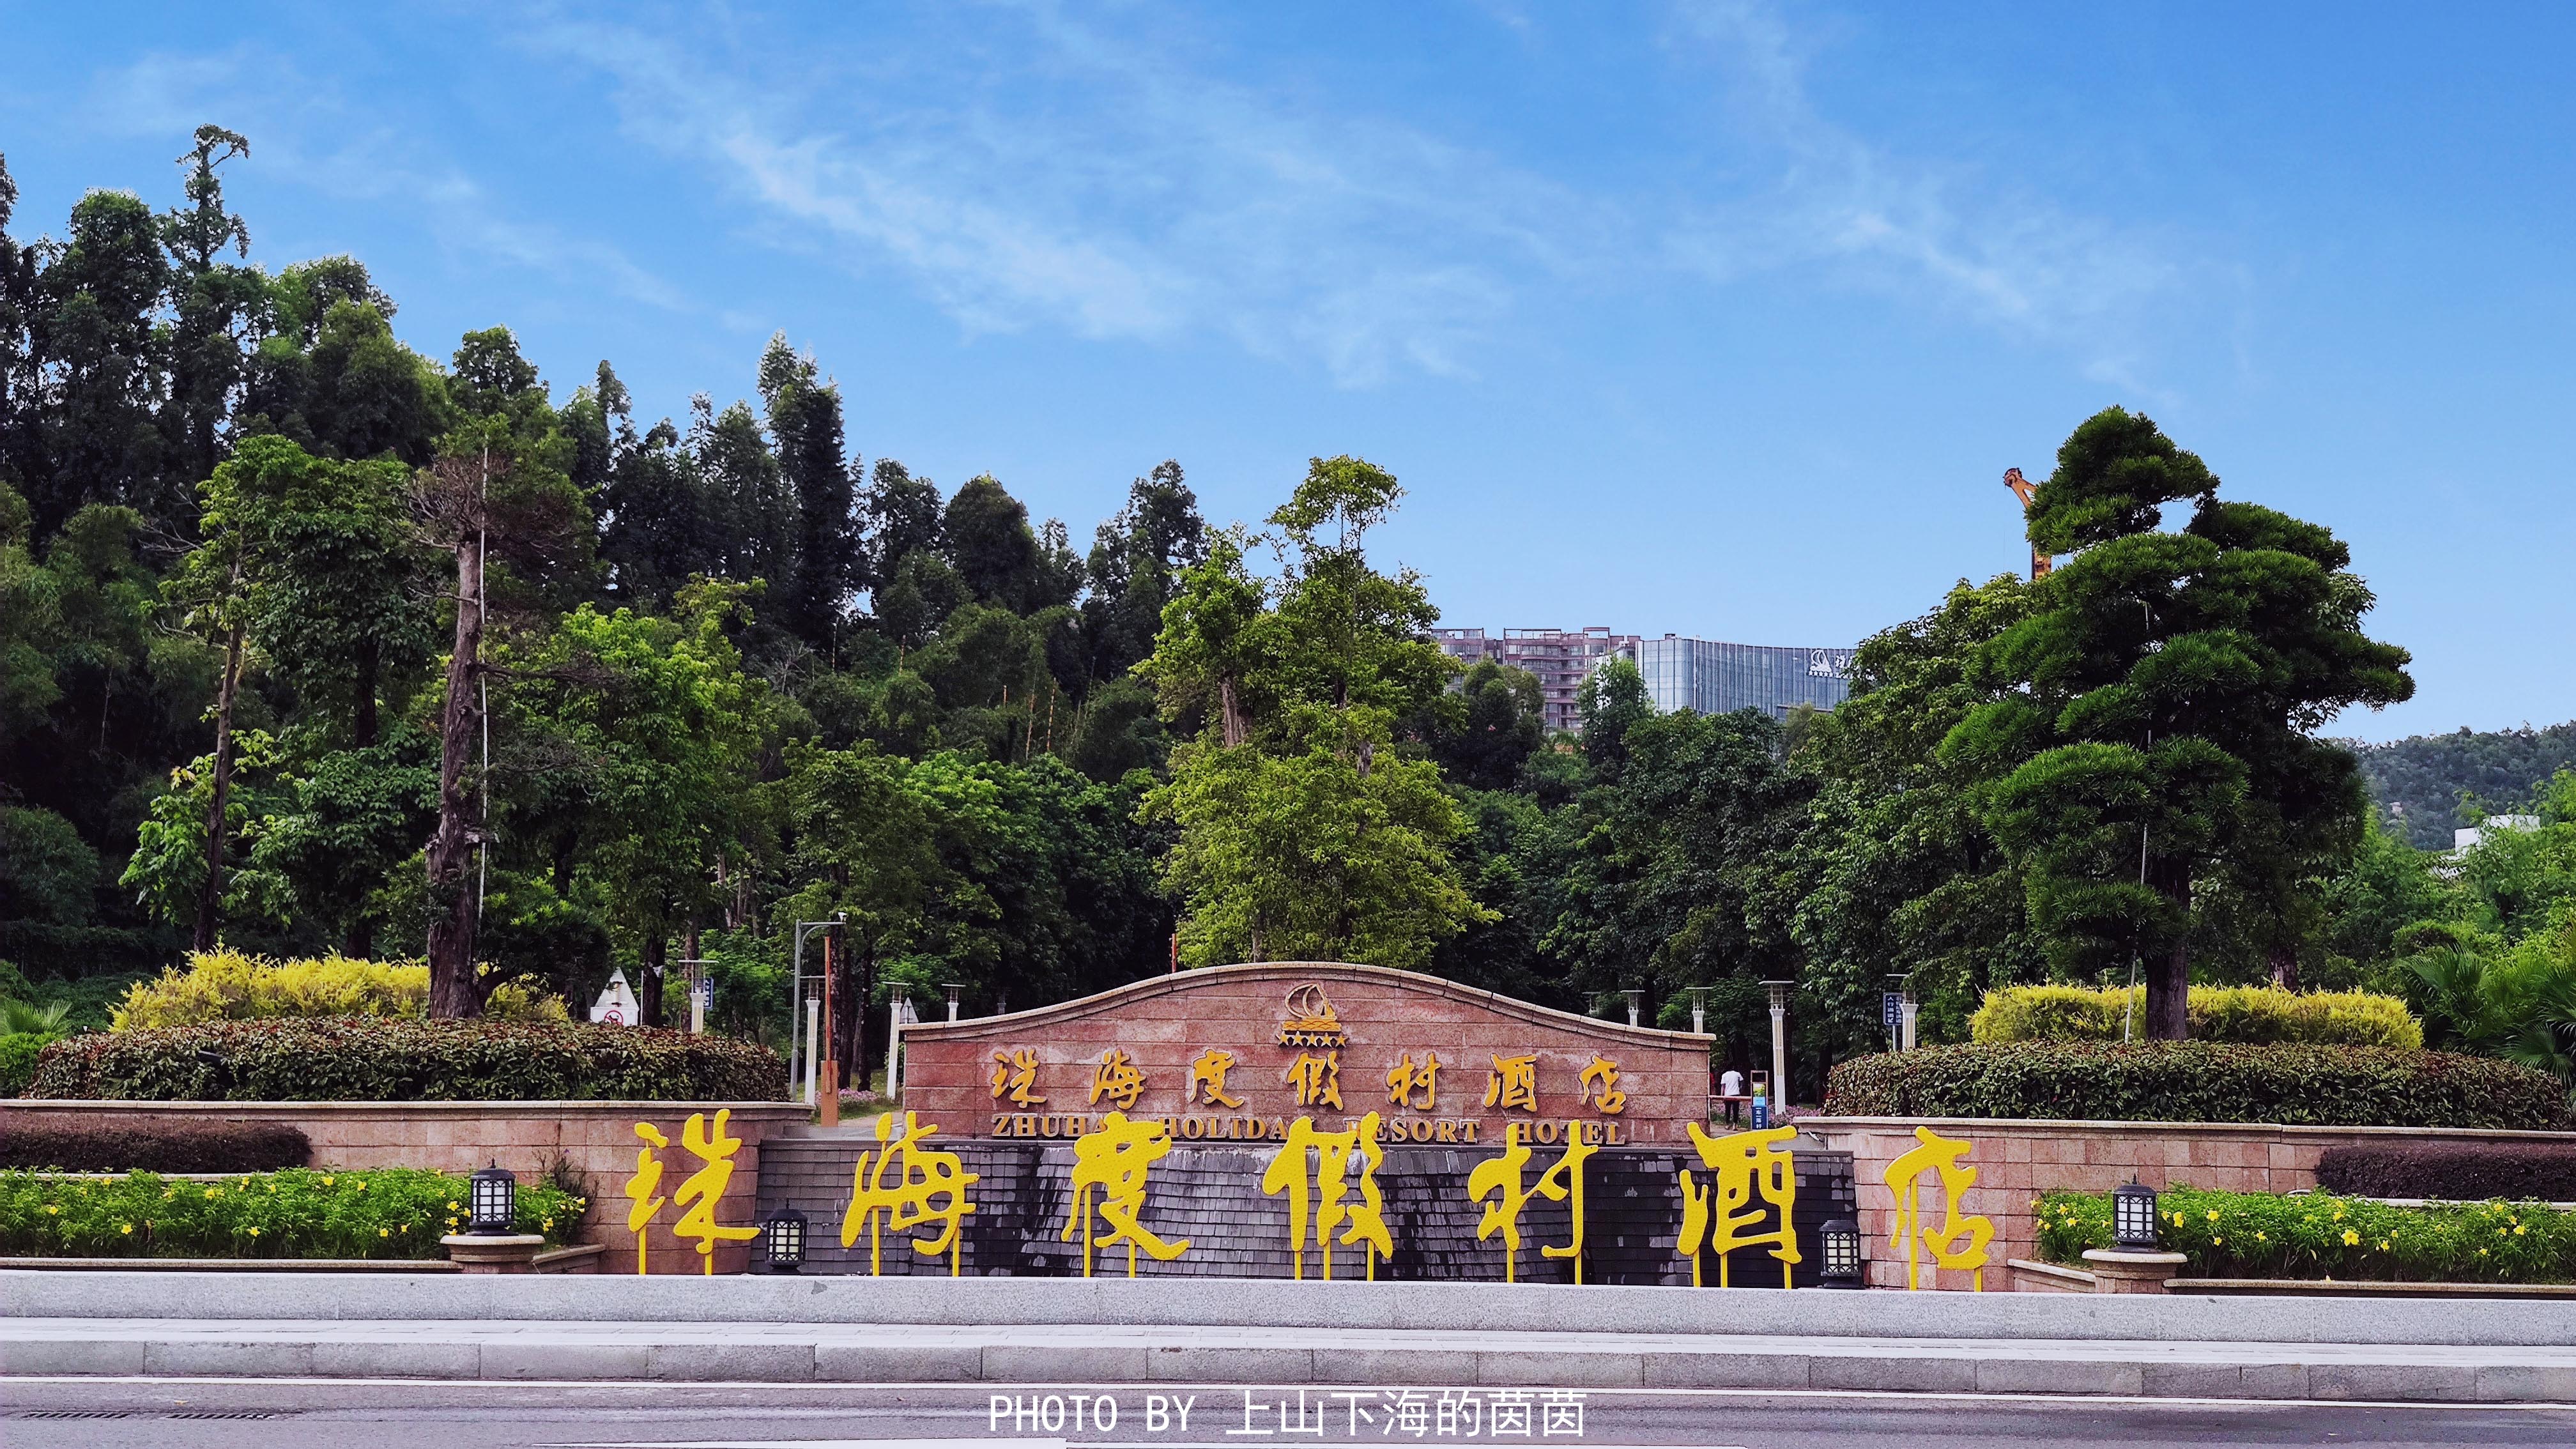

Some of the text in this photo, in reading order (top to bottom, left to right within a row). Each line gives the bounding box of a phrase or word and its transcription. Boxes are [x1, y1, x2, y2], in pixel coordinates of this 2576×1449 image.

[991, 1048, 1627, 1114] 珠海度假村酒店
[992, 1113, 1128, 1137] ZHUHA
[1158, 1115, 1315, 1140] HOLIDA
[625, 1110, 1995, 1270] 珠海度假村酒店
